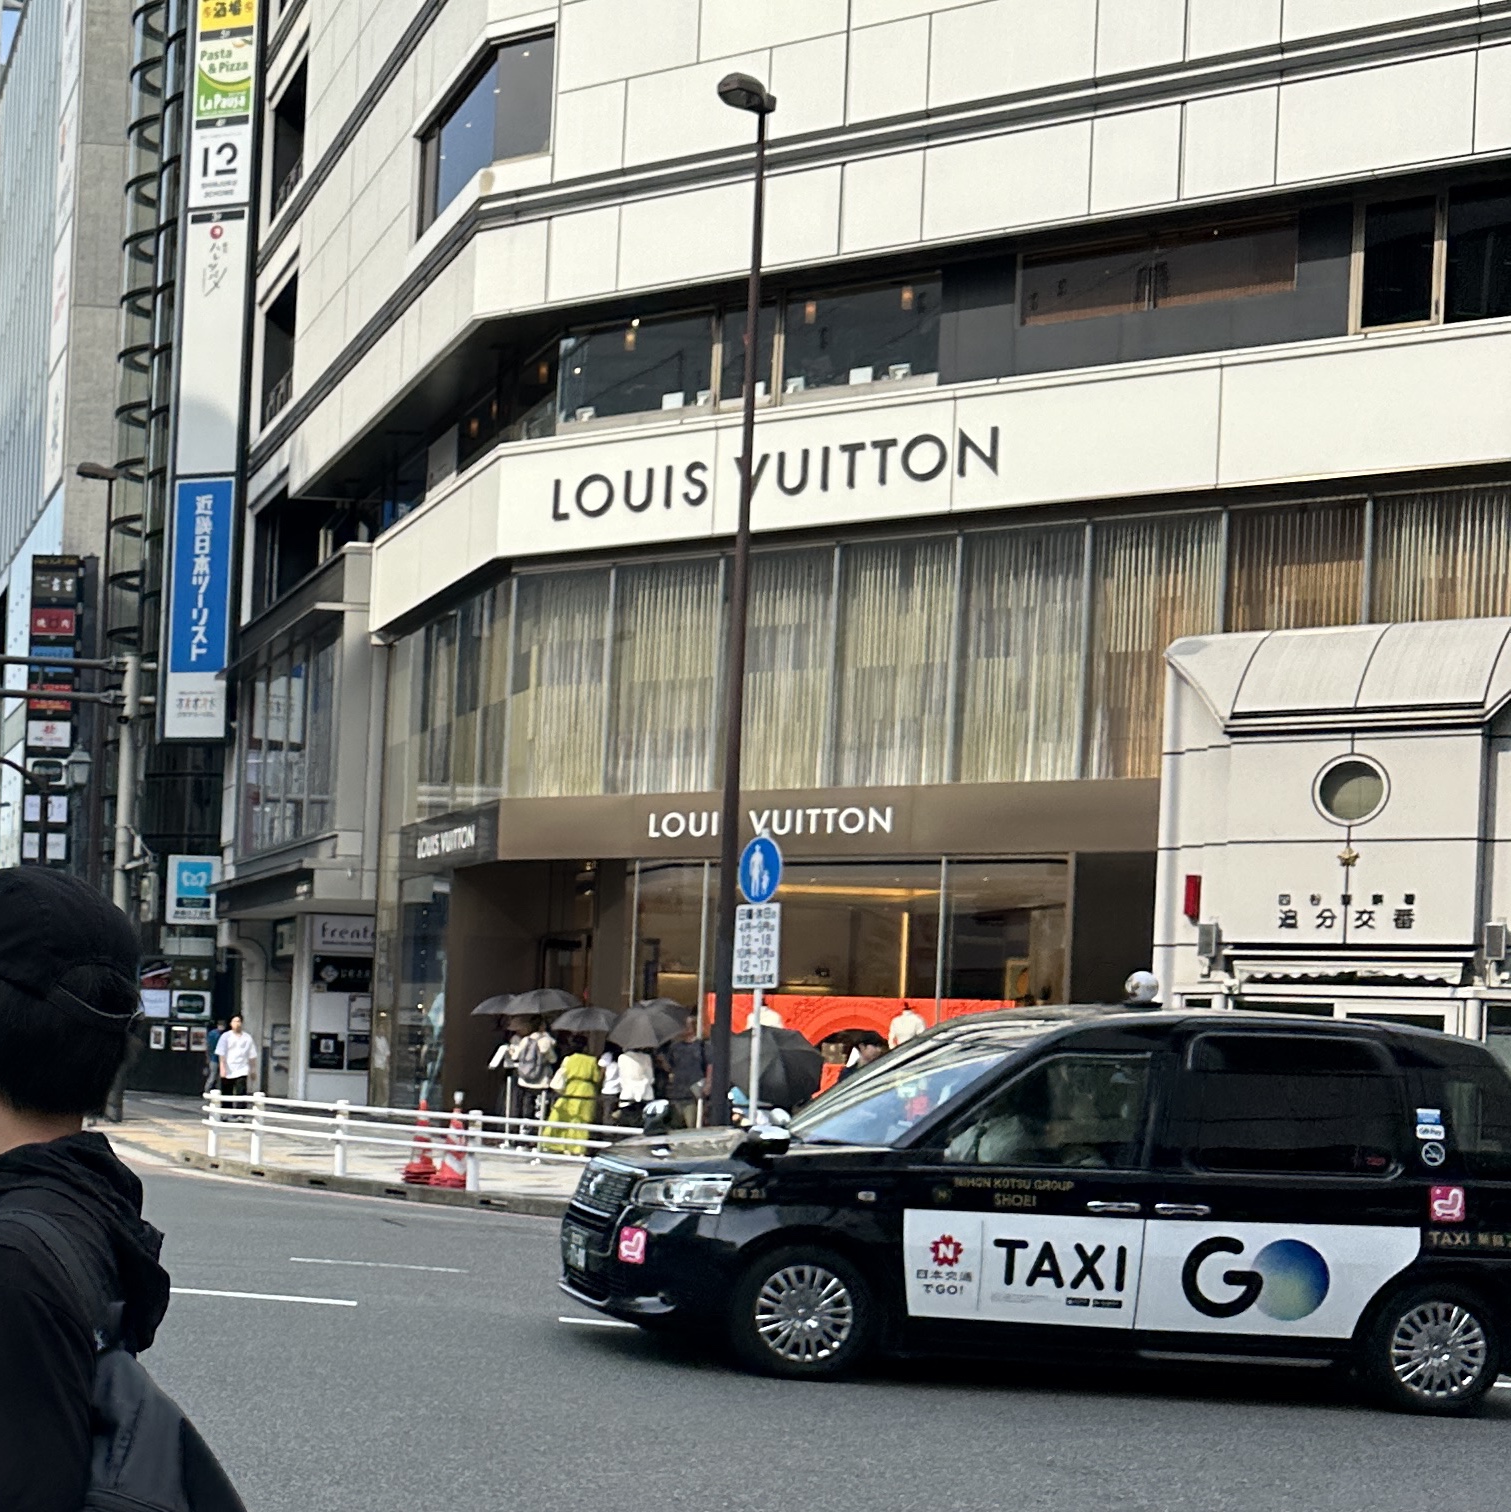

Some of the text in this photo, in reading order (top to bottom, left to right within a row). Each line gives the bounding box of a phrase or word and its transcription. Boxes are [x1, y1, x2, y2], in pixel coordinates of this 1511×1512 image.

[200, 49, 233, 61] Pasta
[208, 61, 248, 74] & Pizza
[552, 425, 1000, 522] LOUIS VUITTON
[190, 494, 214, 662] 近畿日本ツーリスト
[648, 806, 893, 838] LOUI VUITTON
[1278, 909, 1415, 929] 追分交番
[954, 1176, 1075, 1191] NIHON KOTSU GROUP
[994, 1193, 1037, 1207] SHOEI
[1429, 1232, 1471, 1246] TAXI
[993, 1238, 1127, 1293] TAXI
[916, 1269, 973, 1282] 日本交通
